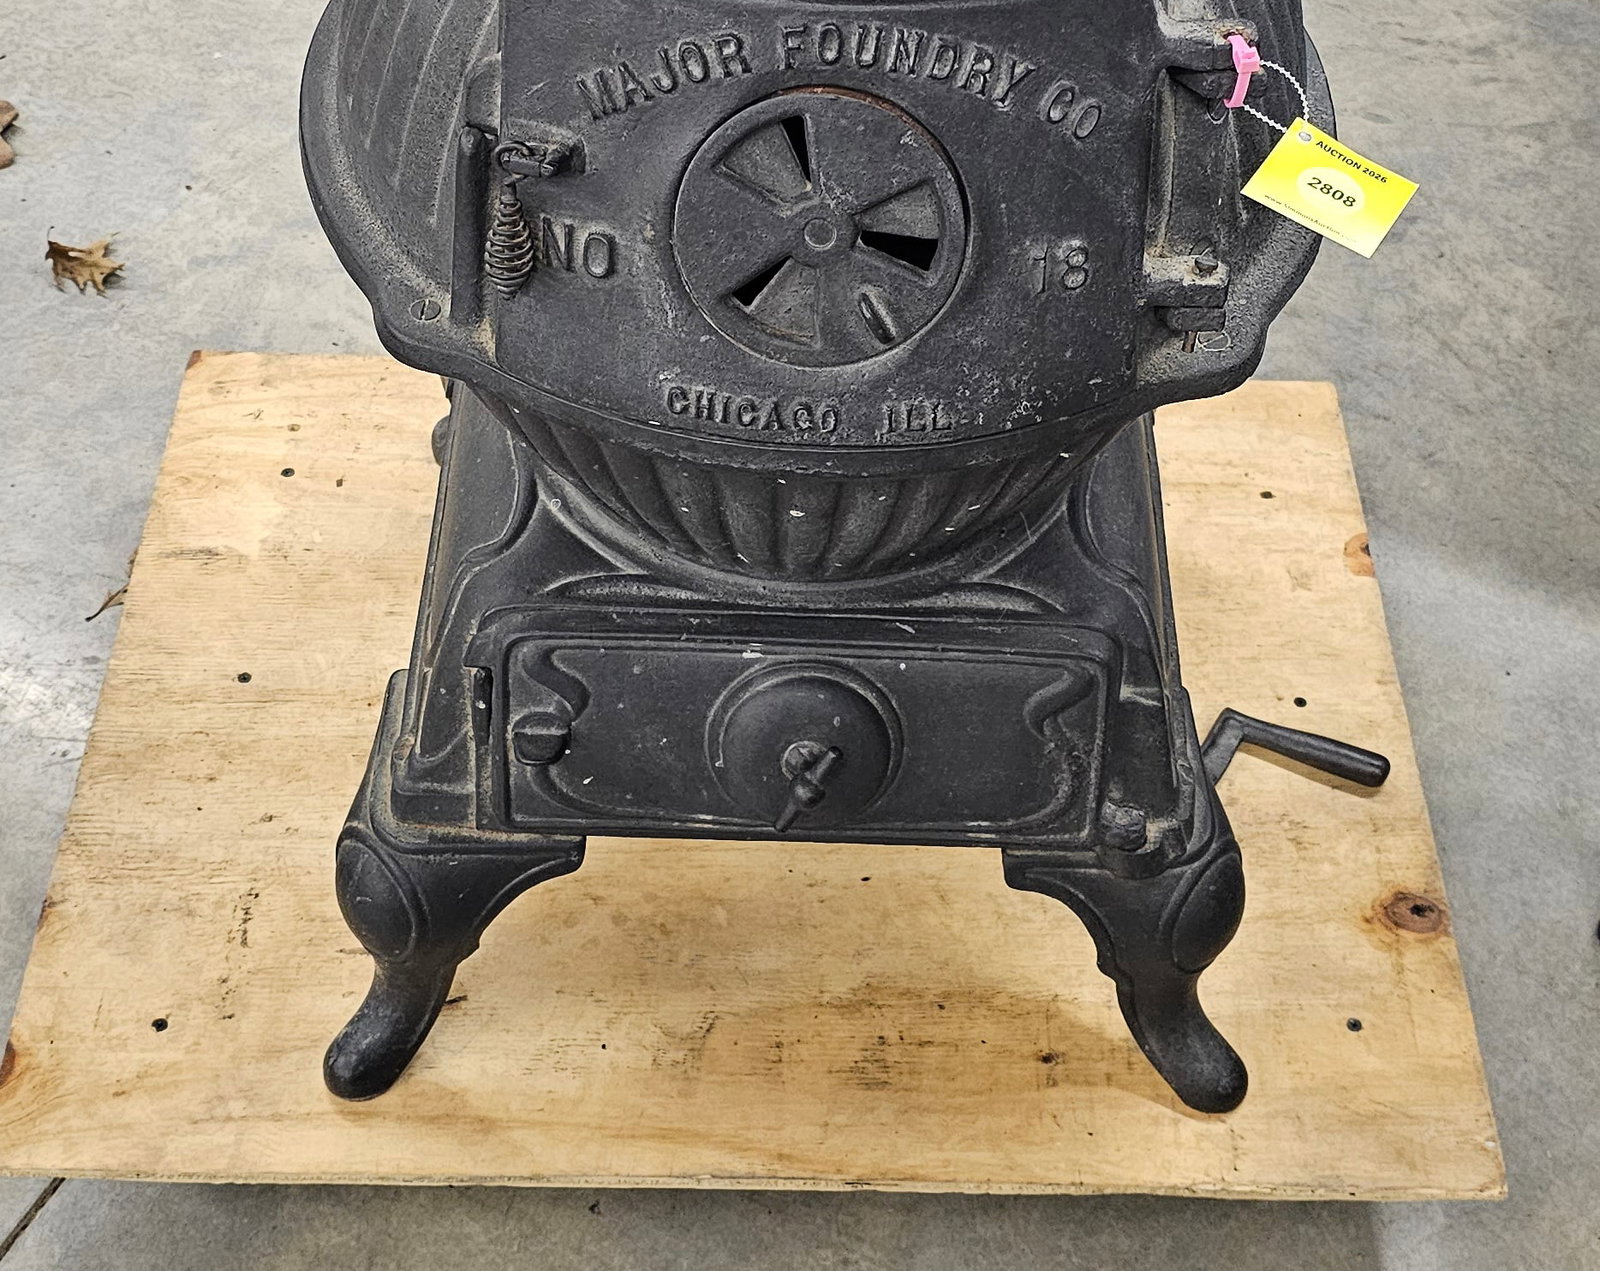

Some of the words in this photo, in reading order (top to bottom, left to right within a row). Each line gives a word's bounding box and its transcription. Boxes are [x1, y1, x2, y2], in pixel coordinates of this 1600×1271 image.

[576, 31, 753, 120] MAJOR
[779, 22, 1036, 111] FOUNDRY
[1041, 79, 1102, 140] CO
[1315, 140, 1362, 170] AUCTION
[1362, 167, 1388, 184] 2026
[1306, 176, 1357, 208] 2808
[538, 213, 617, 279] NO
[1029, 239, 1090, 296] 18
[665, 385, 841, 433] CHICAGO
